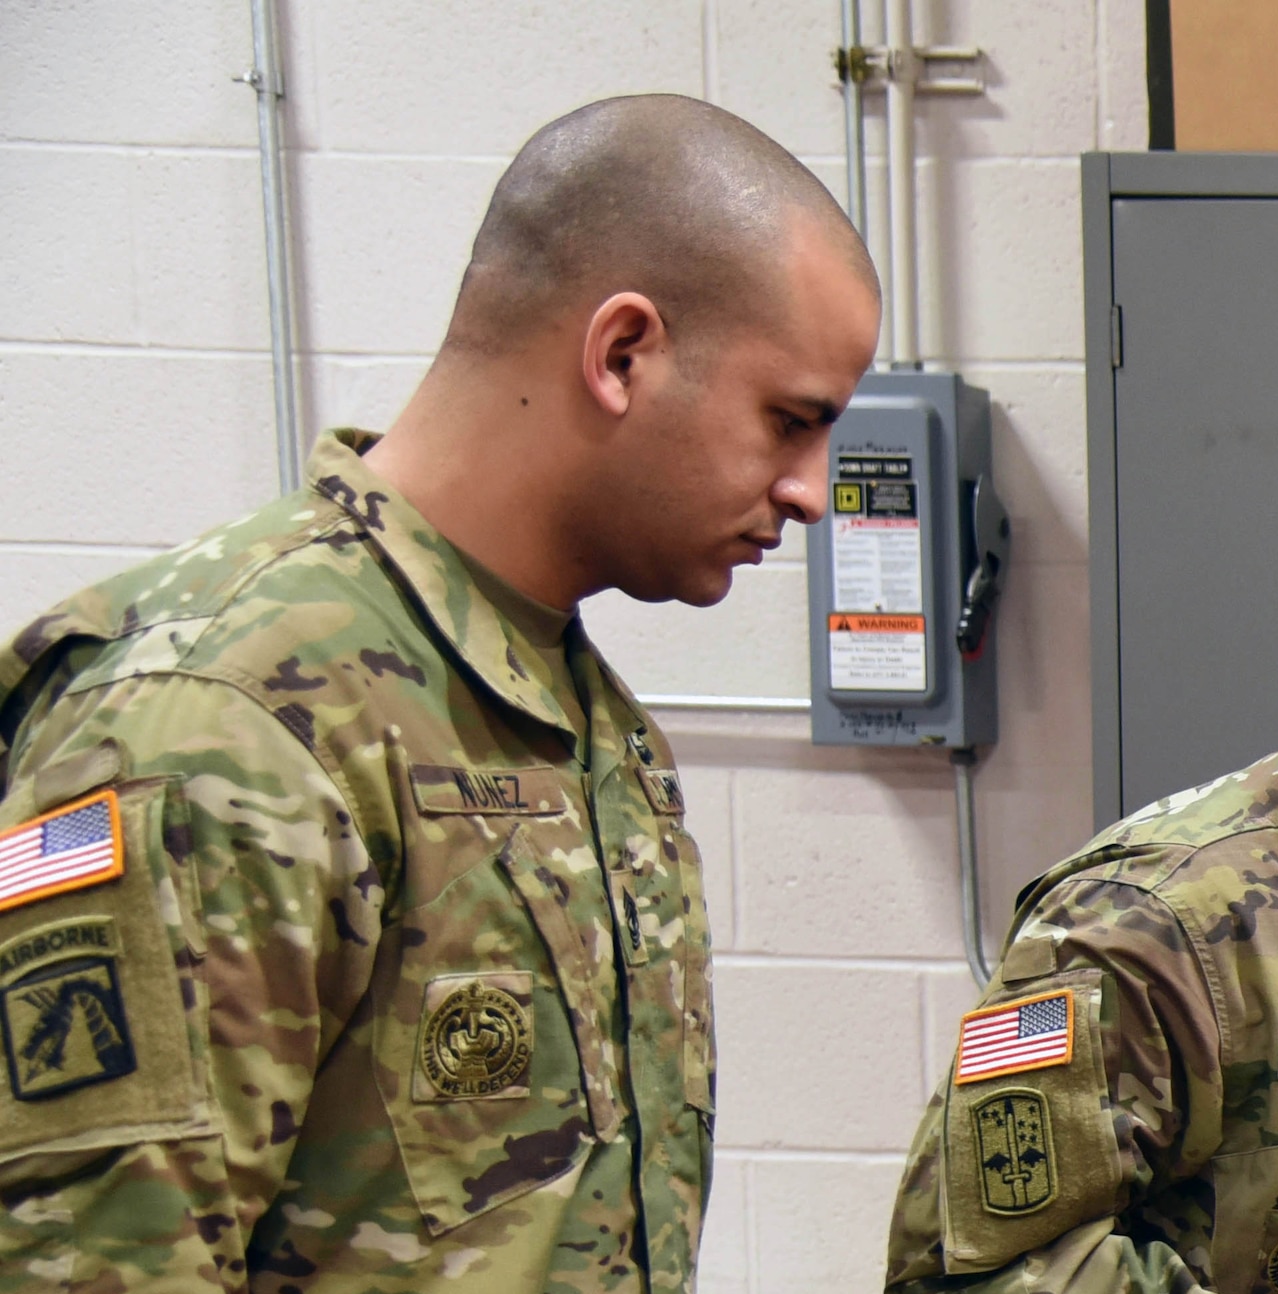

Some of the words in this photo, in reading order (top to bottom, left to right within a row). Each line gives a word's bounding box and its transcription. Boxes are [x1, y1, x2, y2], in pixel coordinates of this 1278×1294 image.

[858, 618, 919, 630] WARNING
[452, 771, 529, 809] NUNEZ
[0, 925, 109, 975] AIRBORNE
